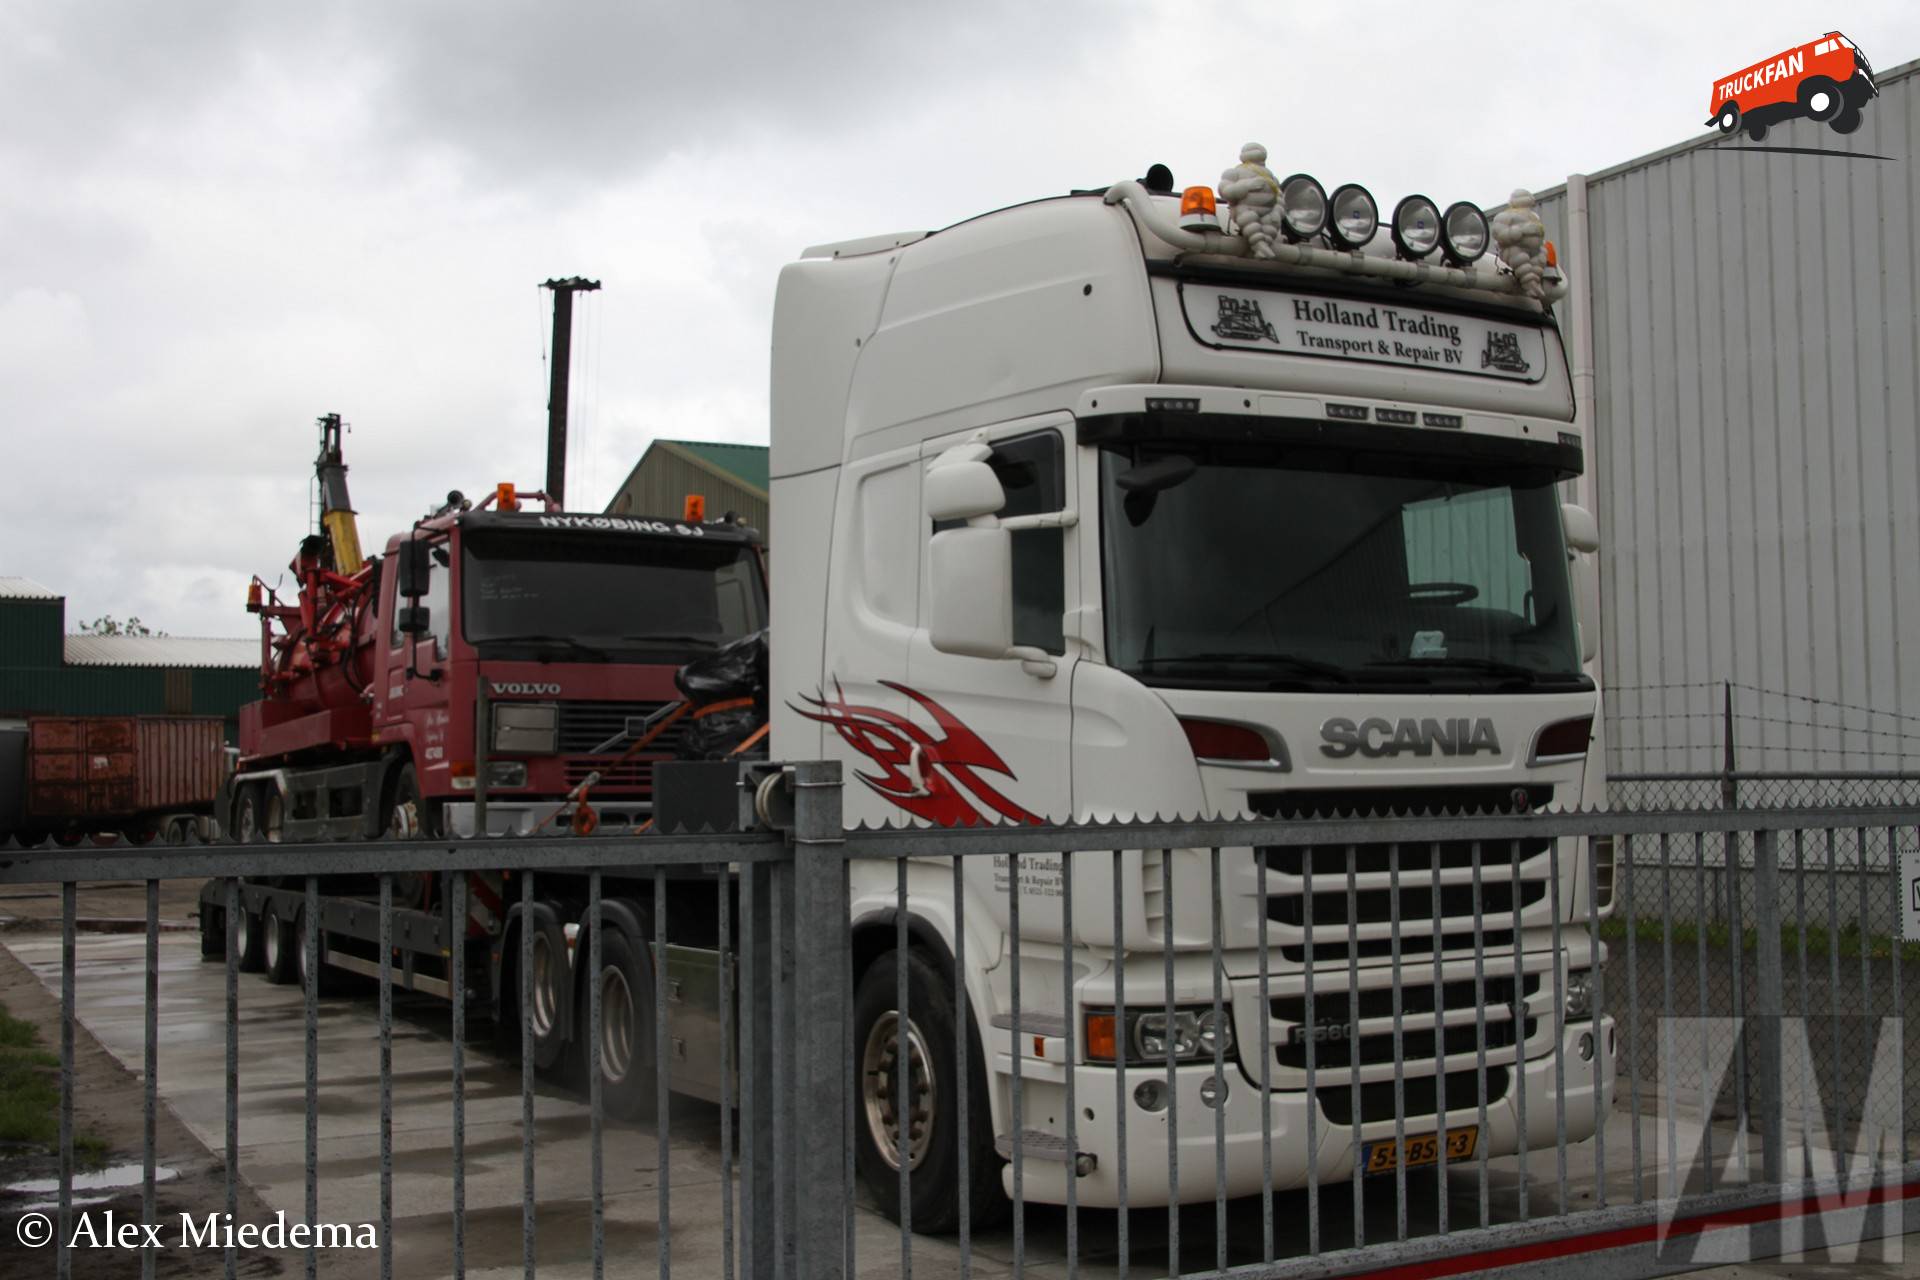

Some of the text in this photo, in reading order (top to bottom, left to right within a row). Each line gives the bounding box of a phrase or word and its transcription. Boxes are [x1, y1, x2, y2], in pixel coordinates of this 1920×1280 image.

[1292, 299, 1462, 347] Holland Trading
[1296, 330, 1463, 365] Transport & Repair BV
[539, 516, 671, 533] NYKØBING
[492, 683, 561, 694] VOLVO
[1319, 717, 1501, 759] SCANIA
